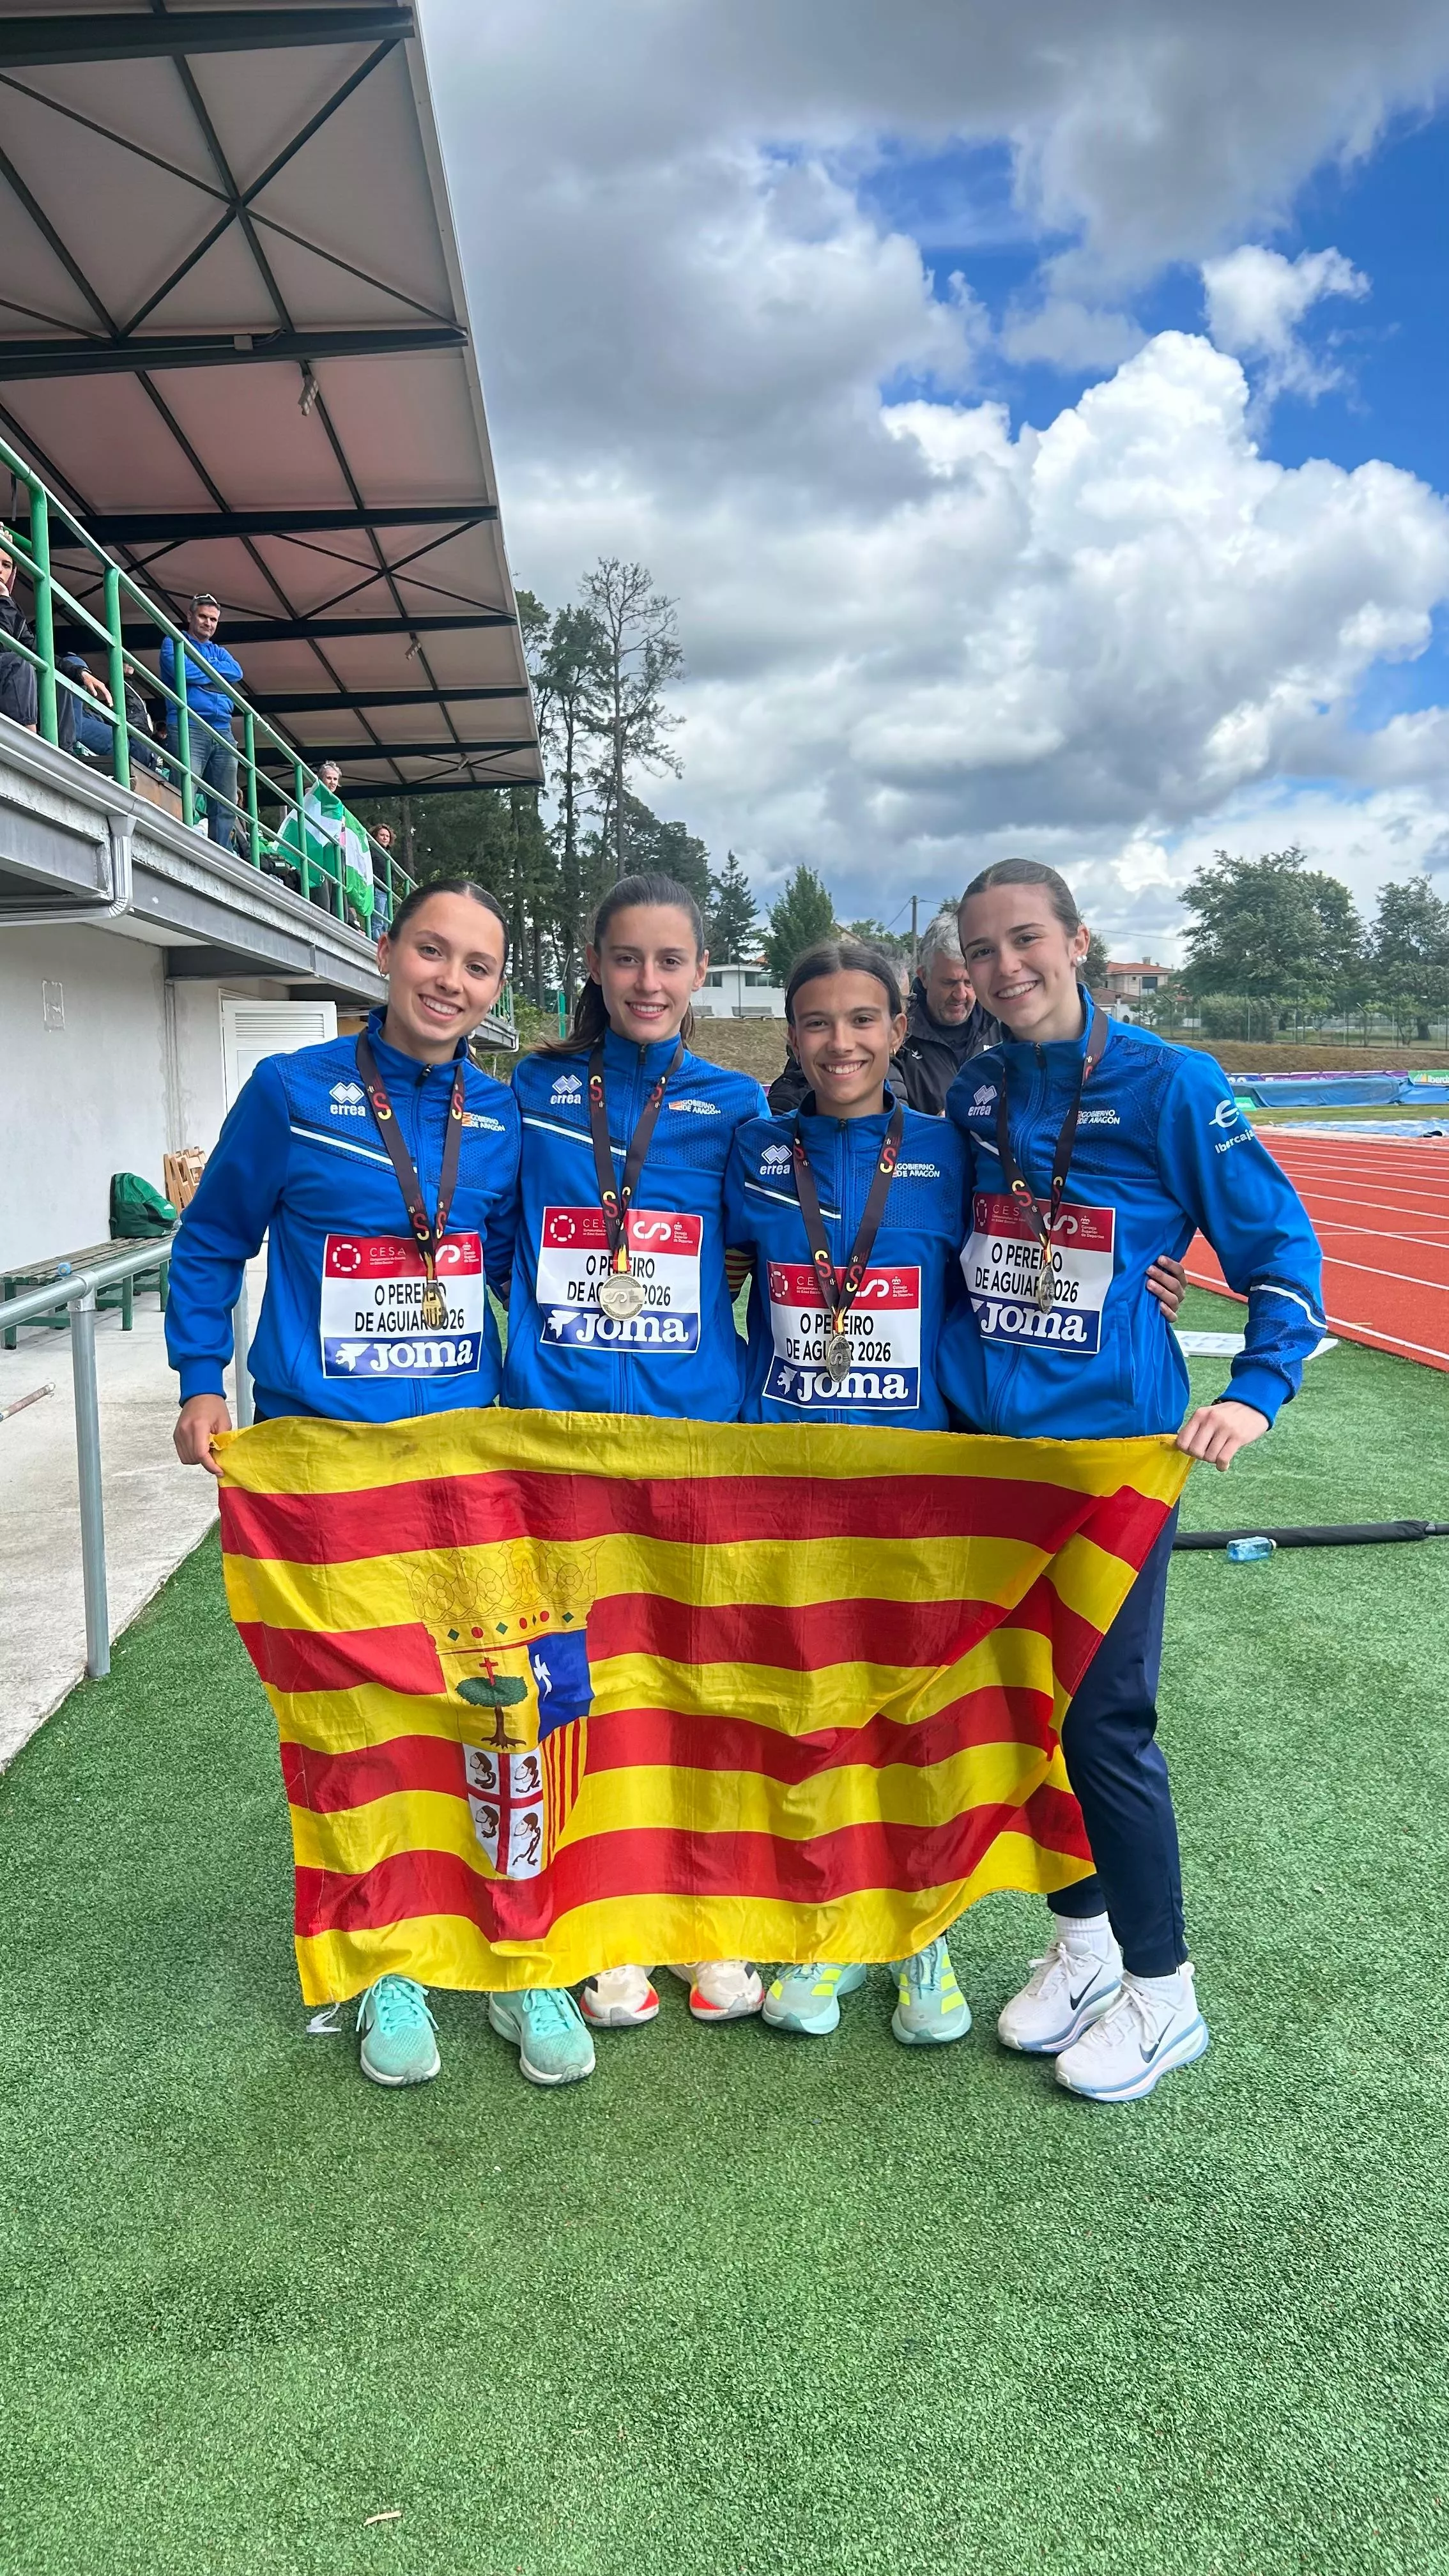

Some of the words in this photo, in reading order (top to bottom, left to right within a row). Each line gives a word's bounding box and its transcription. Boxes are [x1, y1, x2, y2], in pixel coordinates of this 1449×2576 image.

[550, 1094, 581, 1105] errea
[330, 1104, 366, 1117] errea
[968, 1105, 992, 1116] errea
[1081, 1110, 1116, 1118] GOBIERNO
[1215, 1129, 1255, 1154] Ibercaja
[760, 1164, 791, 1175] errea
[992, 1204, 1020, 1216] CES
[583, 1218, 606, 1228] CES
[369, 1246, 406, 1257] CESA
[992, 1243, 1003, 1263] O
[1006, 1244, 1062, 1272] PEREIO
[586, 1255, 597, 1276] O
[567, 1281, 586, 1301] DE
[797, 1276, 815, 1286] CE
[975, 1266, 990, 1289] DE
[1054, 1278, 1080, 1303] 026
[375, 1285, 385, 1305] O
[388, 1282, 447, 1305] PERE
[355, 1312, 374, 1332] DE
[576, 1312, 689, 1342] Joma
[800, 1314, 811, 1334] O
[815, 1314, 874, 1336] PEEIRO
[981, 1301, 1087, 1343] Joma
[370, 1339, 473, 1372] Joma
[786, 1338, 800, 1360] DE
[802, 1340, 854, 1361] AGR
[858, 1341, 891, 1362] 2026
[797, 1372, 908, 1402] Joma
